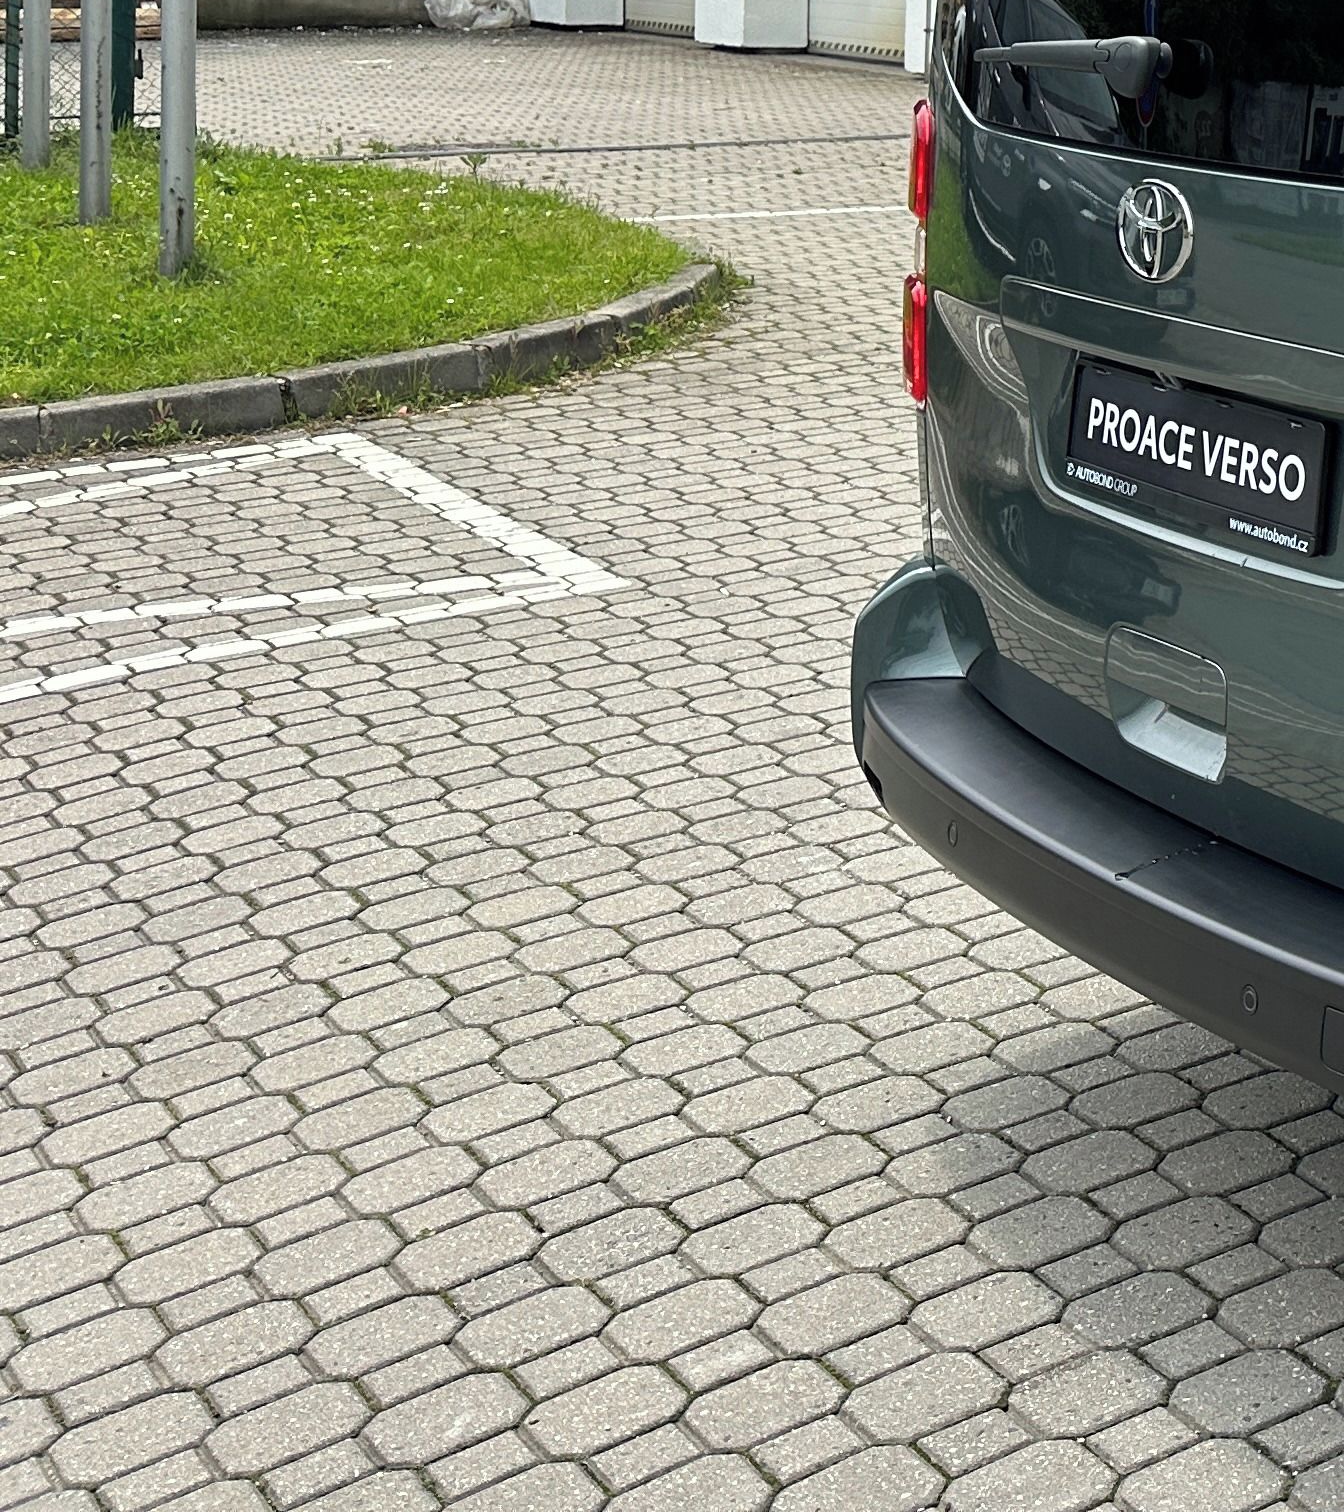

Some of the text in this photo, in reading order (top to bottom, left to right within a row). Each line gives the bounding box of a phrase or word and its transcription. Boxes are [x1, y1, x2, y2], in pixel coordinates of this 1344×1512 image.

[1087, 397, 1306, 501] PROACE VERSO
[1075, 466, 1138, 497] AUTOBOND GROUP
[1229, 517, 1309, 553] www.autobond.cz
